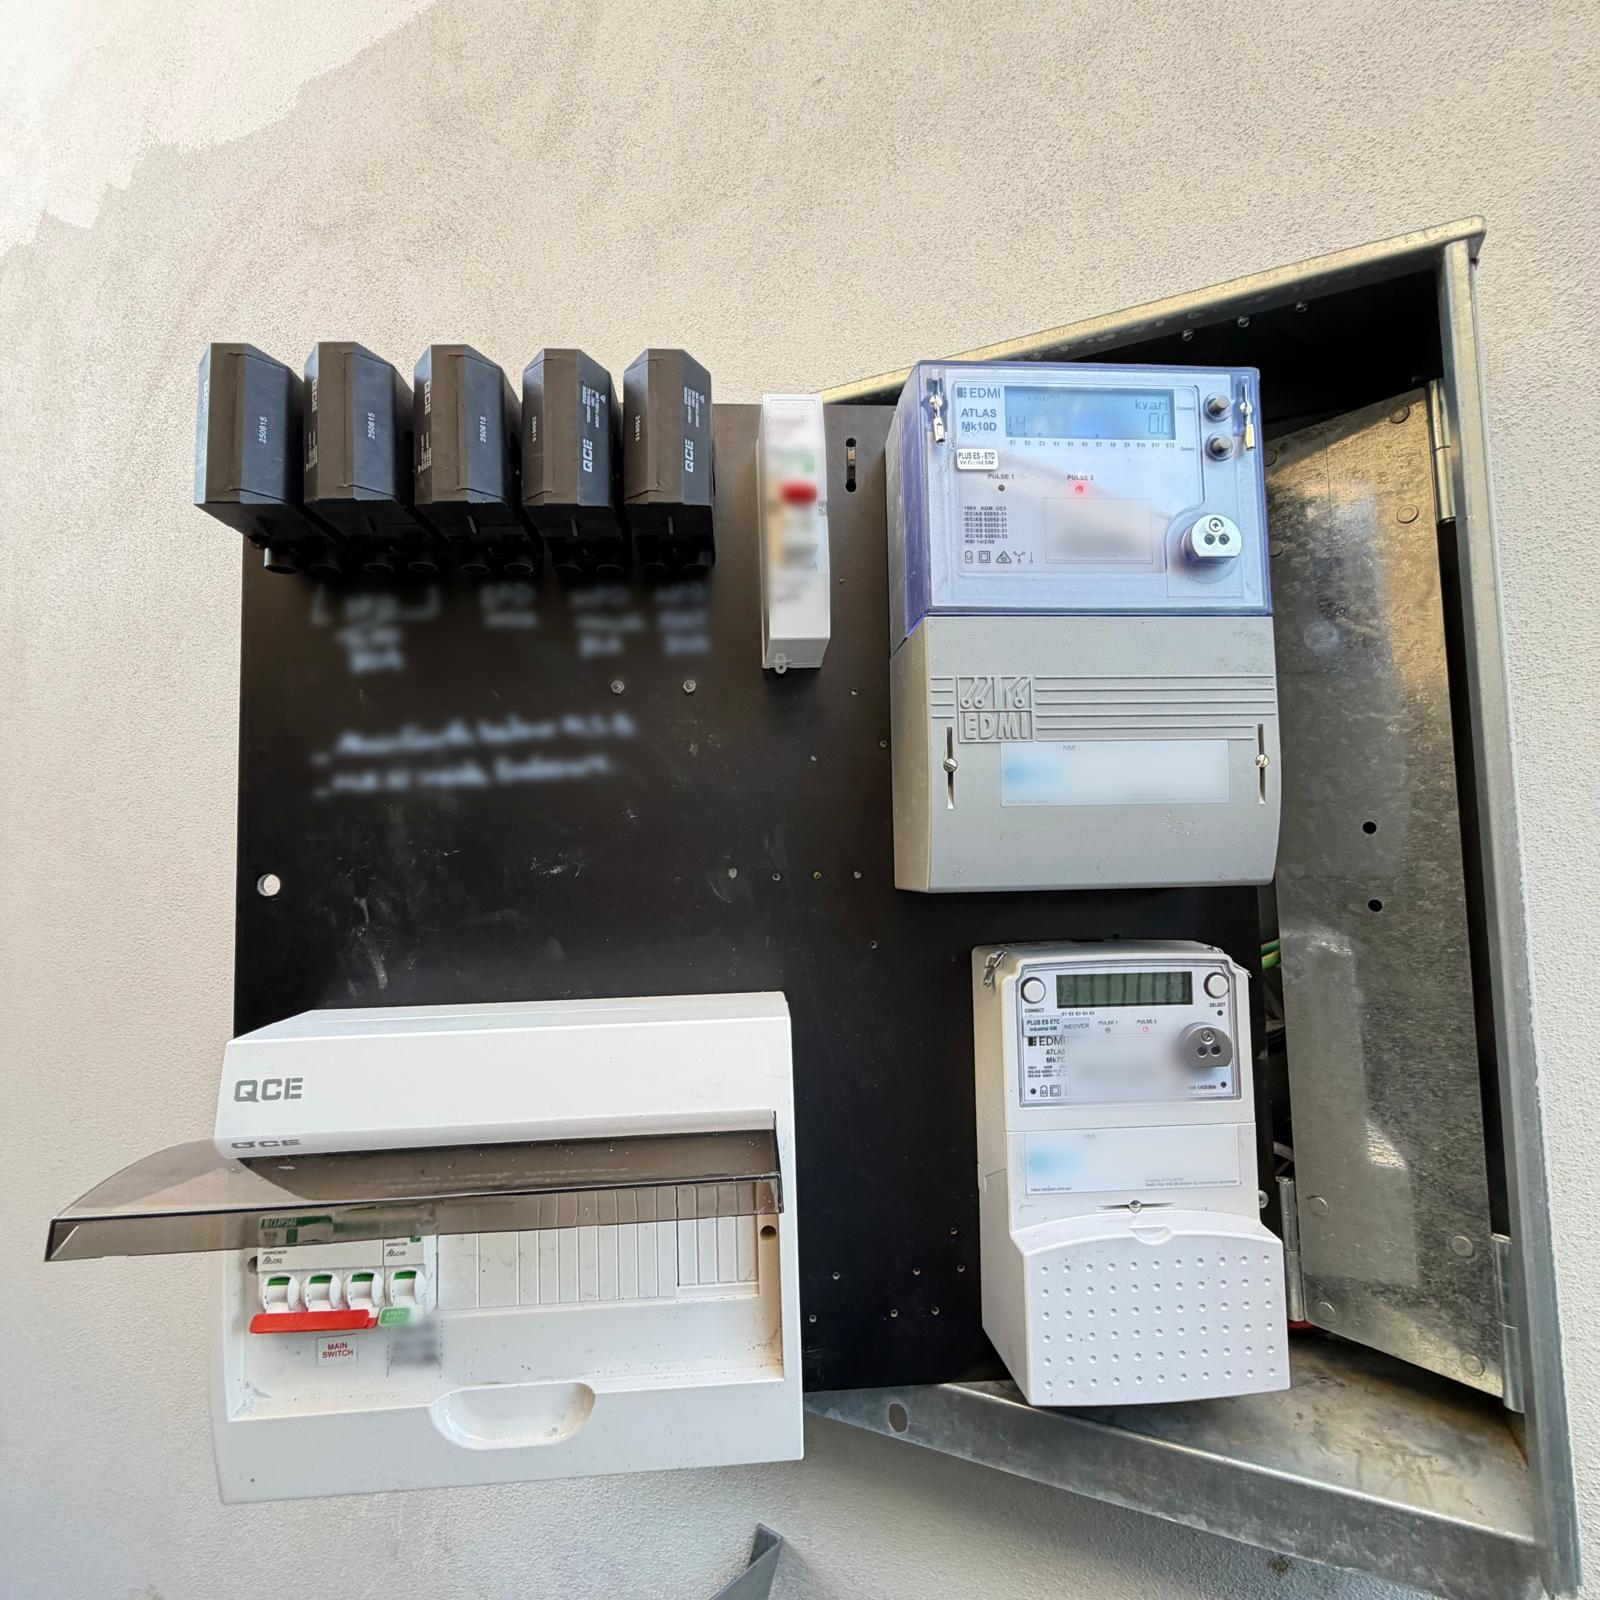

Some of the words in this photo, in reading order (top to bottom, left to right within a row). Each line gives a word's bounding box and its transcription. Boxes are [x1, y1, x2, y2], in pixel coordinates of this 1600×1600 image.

[970, 388, 1000, 398] EDMI
[961, 408, 996, 418] ATLAS
[962, 422, 996, 431] Mk10D
[582, 438, 593, 472] QCE
[684, 439, 694, 472] QCE
[964, 712, 1028, 740] EDMI
[1039, 1036, 1065, 1046] EDMI
[234, 1077, 304, 1102] QCE
[328, 1342, 347, 1350] MAIN
[322, 1349, 353, 1358] SWITCH
